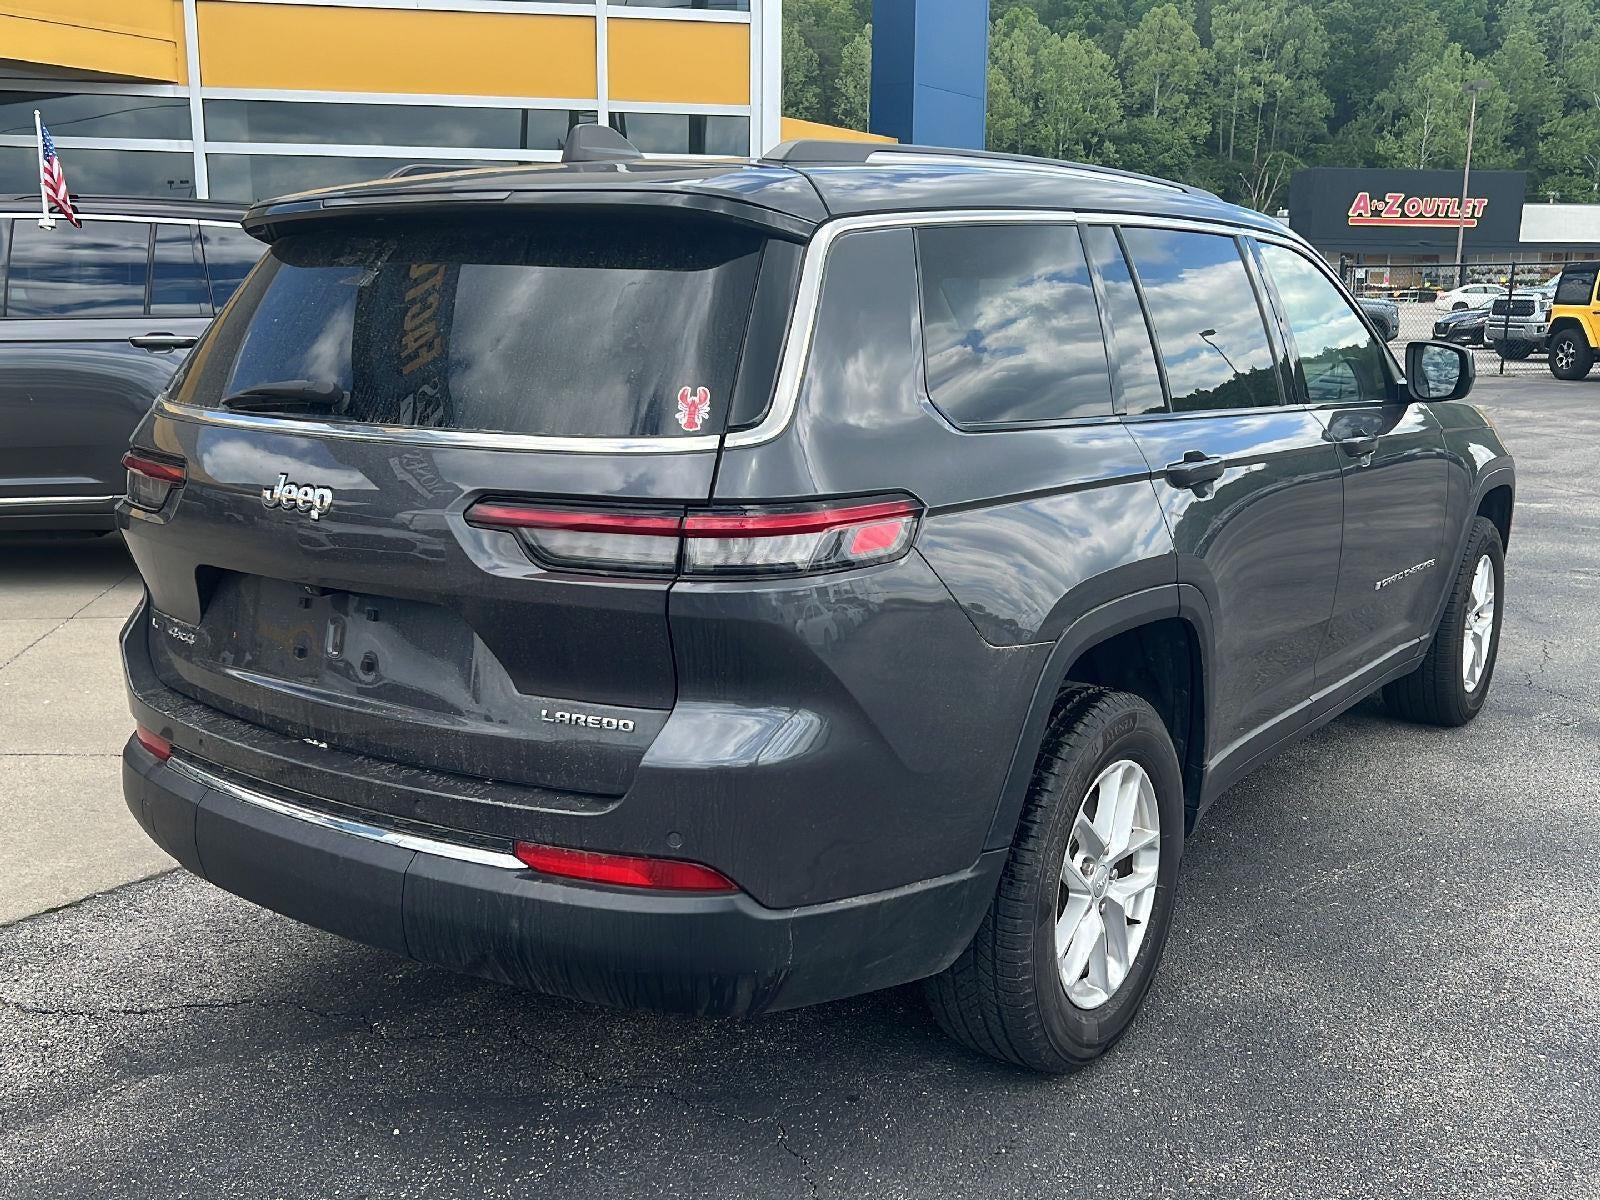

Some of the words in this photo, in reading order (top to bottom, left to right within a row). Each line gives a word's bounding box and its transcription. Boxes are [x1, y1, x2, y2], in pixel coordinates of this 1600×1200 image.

[1404, 197, 1488, 218] OUTLET
[262, 473, 333, 521] Jeep
[541, 709, 635, 733] LAREDO
